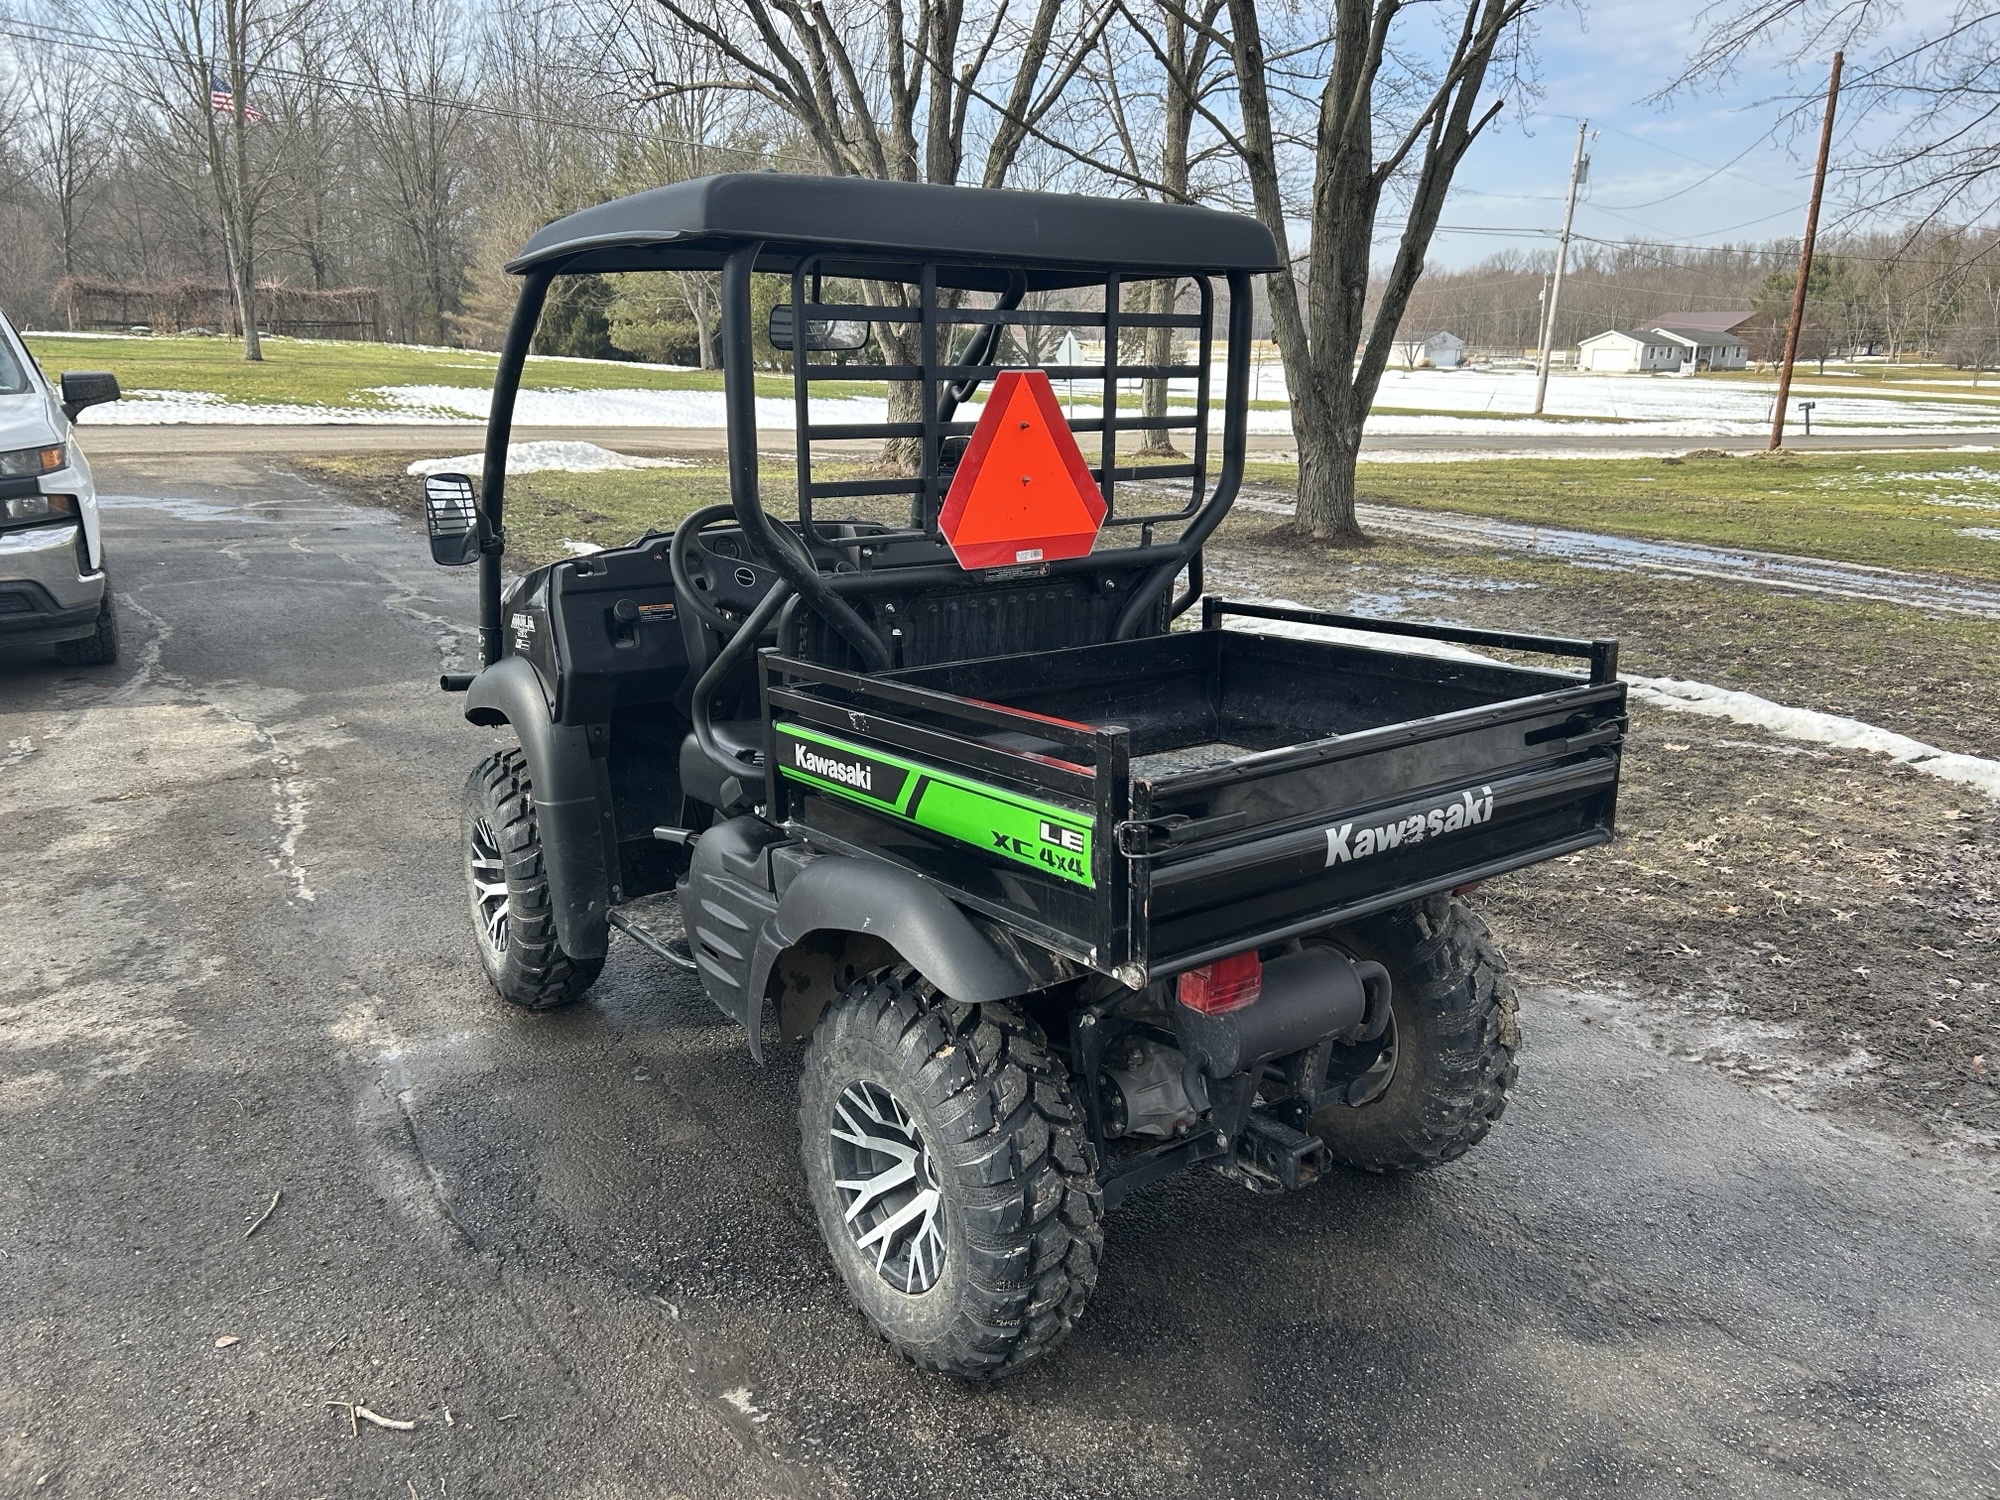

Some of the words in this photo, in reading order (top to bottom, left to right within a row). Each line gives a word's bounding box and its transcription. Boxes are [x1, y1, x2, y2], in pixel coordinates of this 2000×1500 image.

[795, 743, 872, 791] Kawasaki
[991, 830, 1035, 860] XC
[1040, 820, 1084, 855] LE
[1324, 785, 1494, 868] Kawasaki
